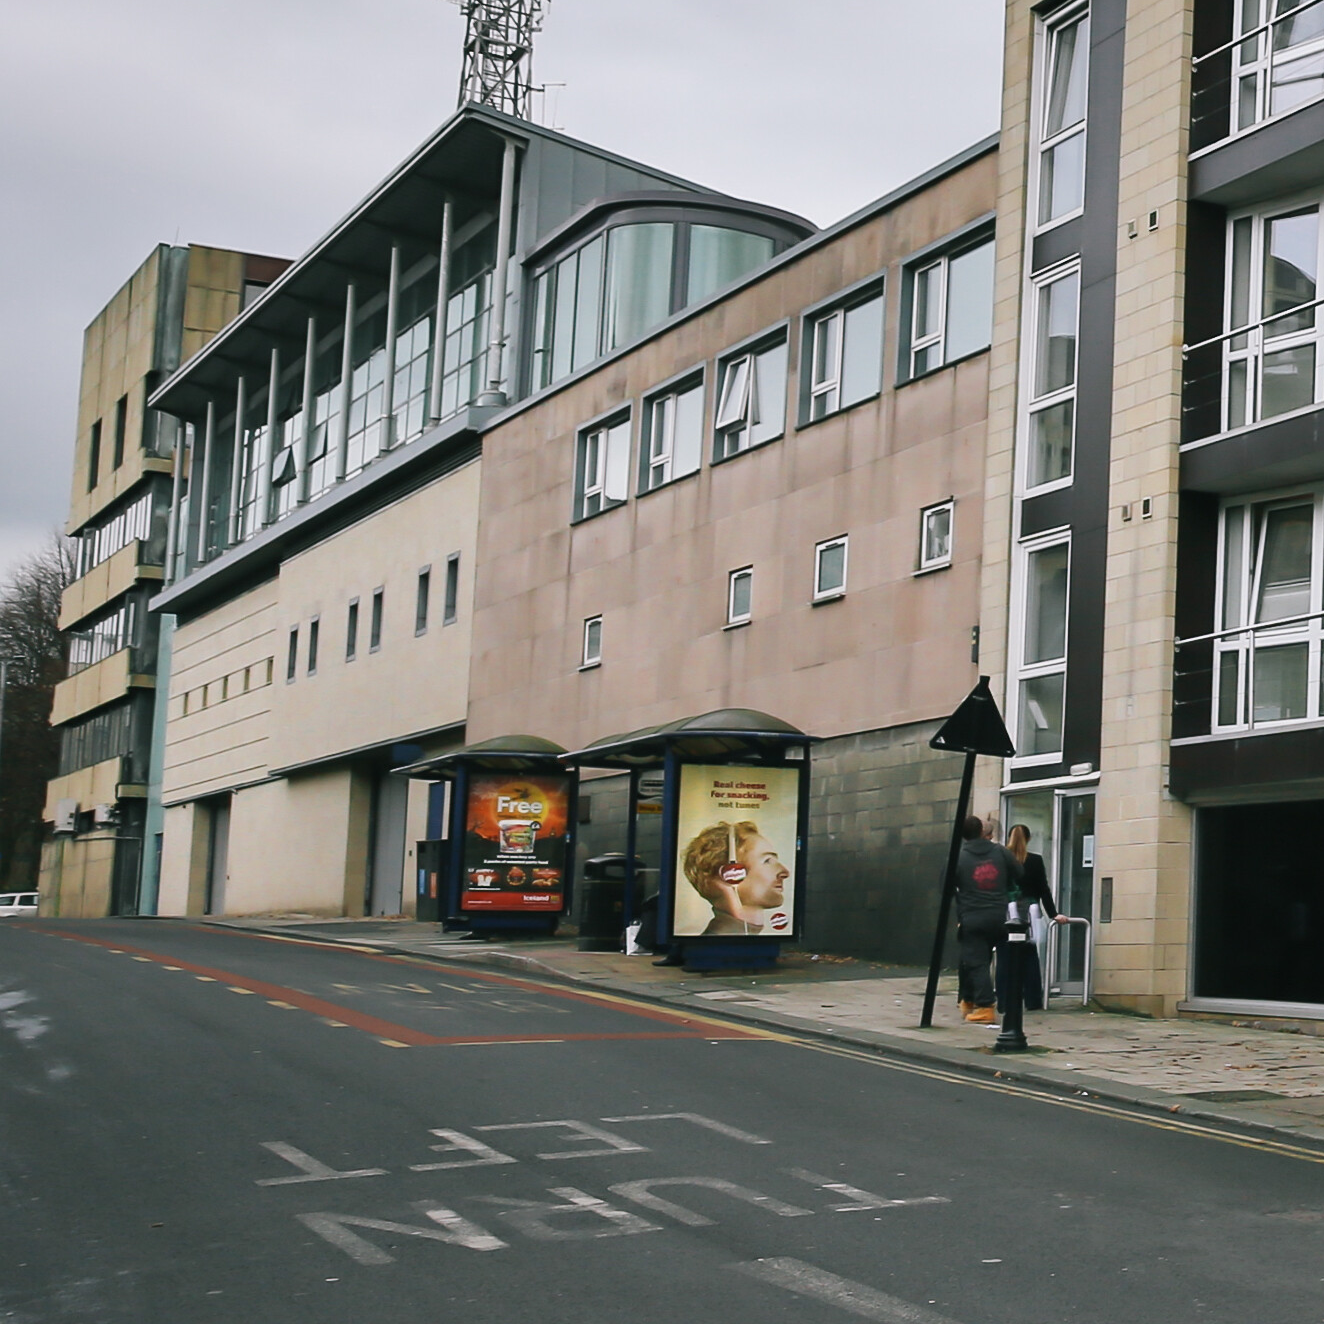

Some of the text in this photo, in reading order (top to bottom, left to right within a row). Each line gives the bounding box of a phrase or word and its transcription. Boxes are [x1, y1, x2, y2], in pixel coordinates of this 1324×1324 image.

[497, 796, 543, 813] Free
[713, 780, 733, 788] Real
[255, 1111, 775, 1188] LEFT
[294, 1166, 953, 1266] TURN
